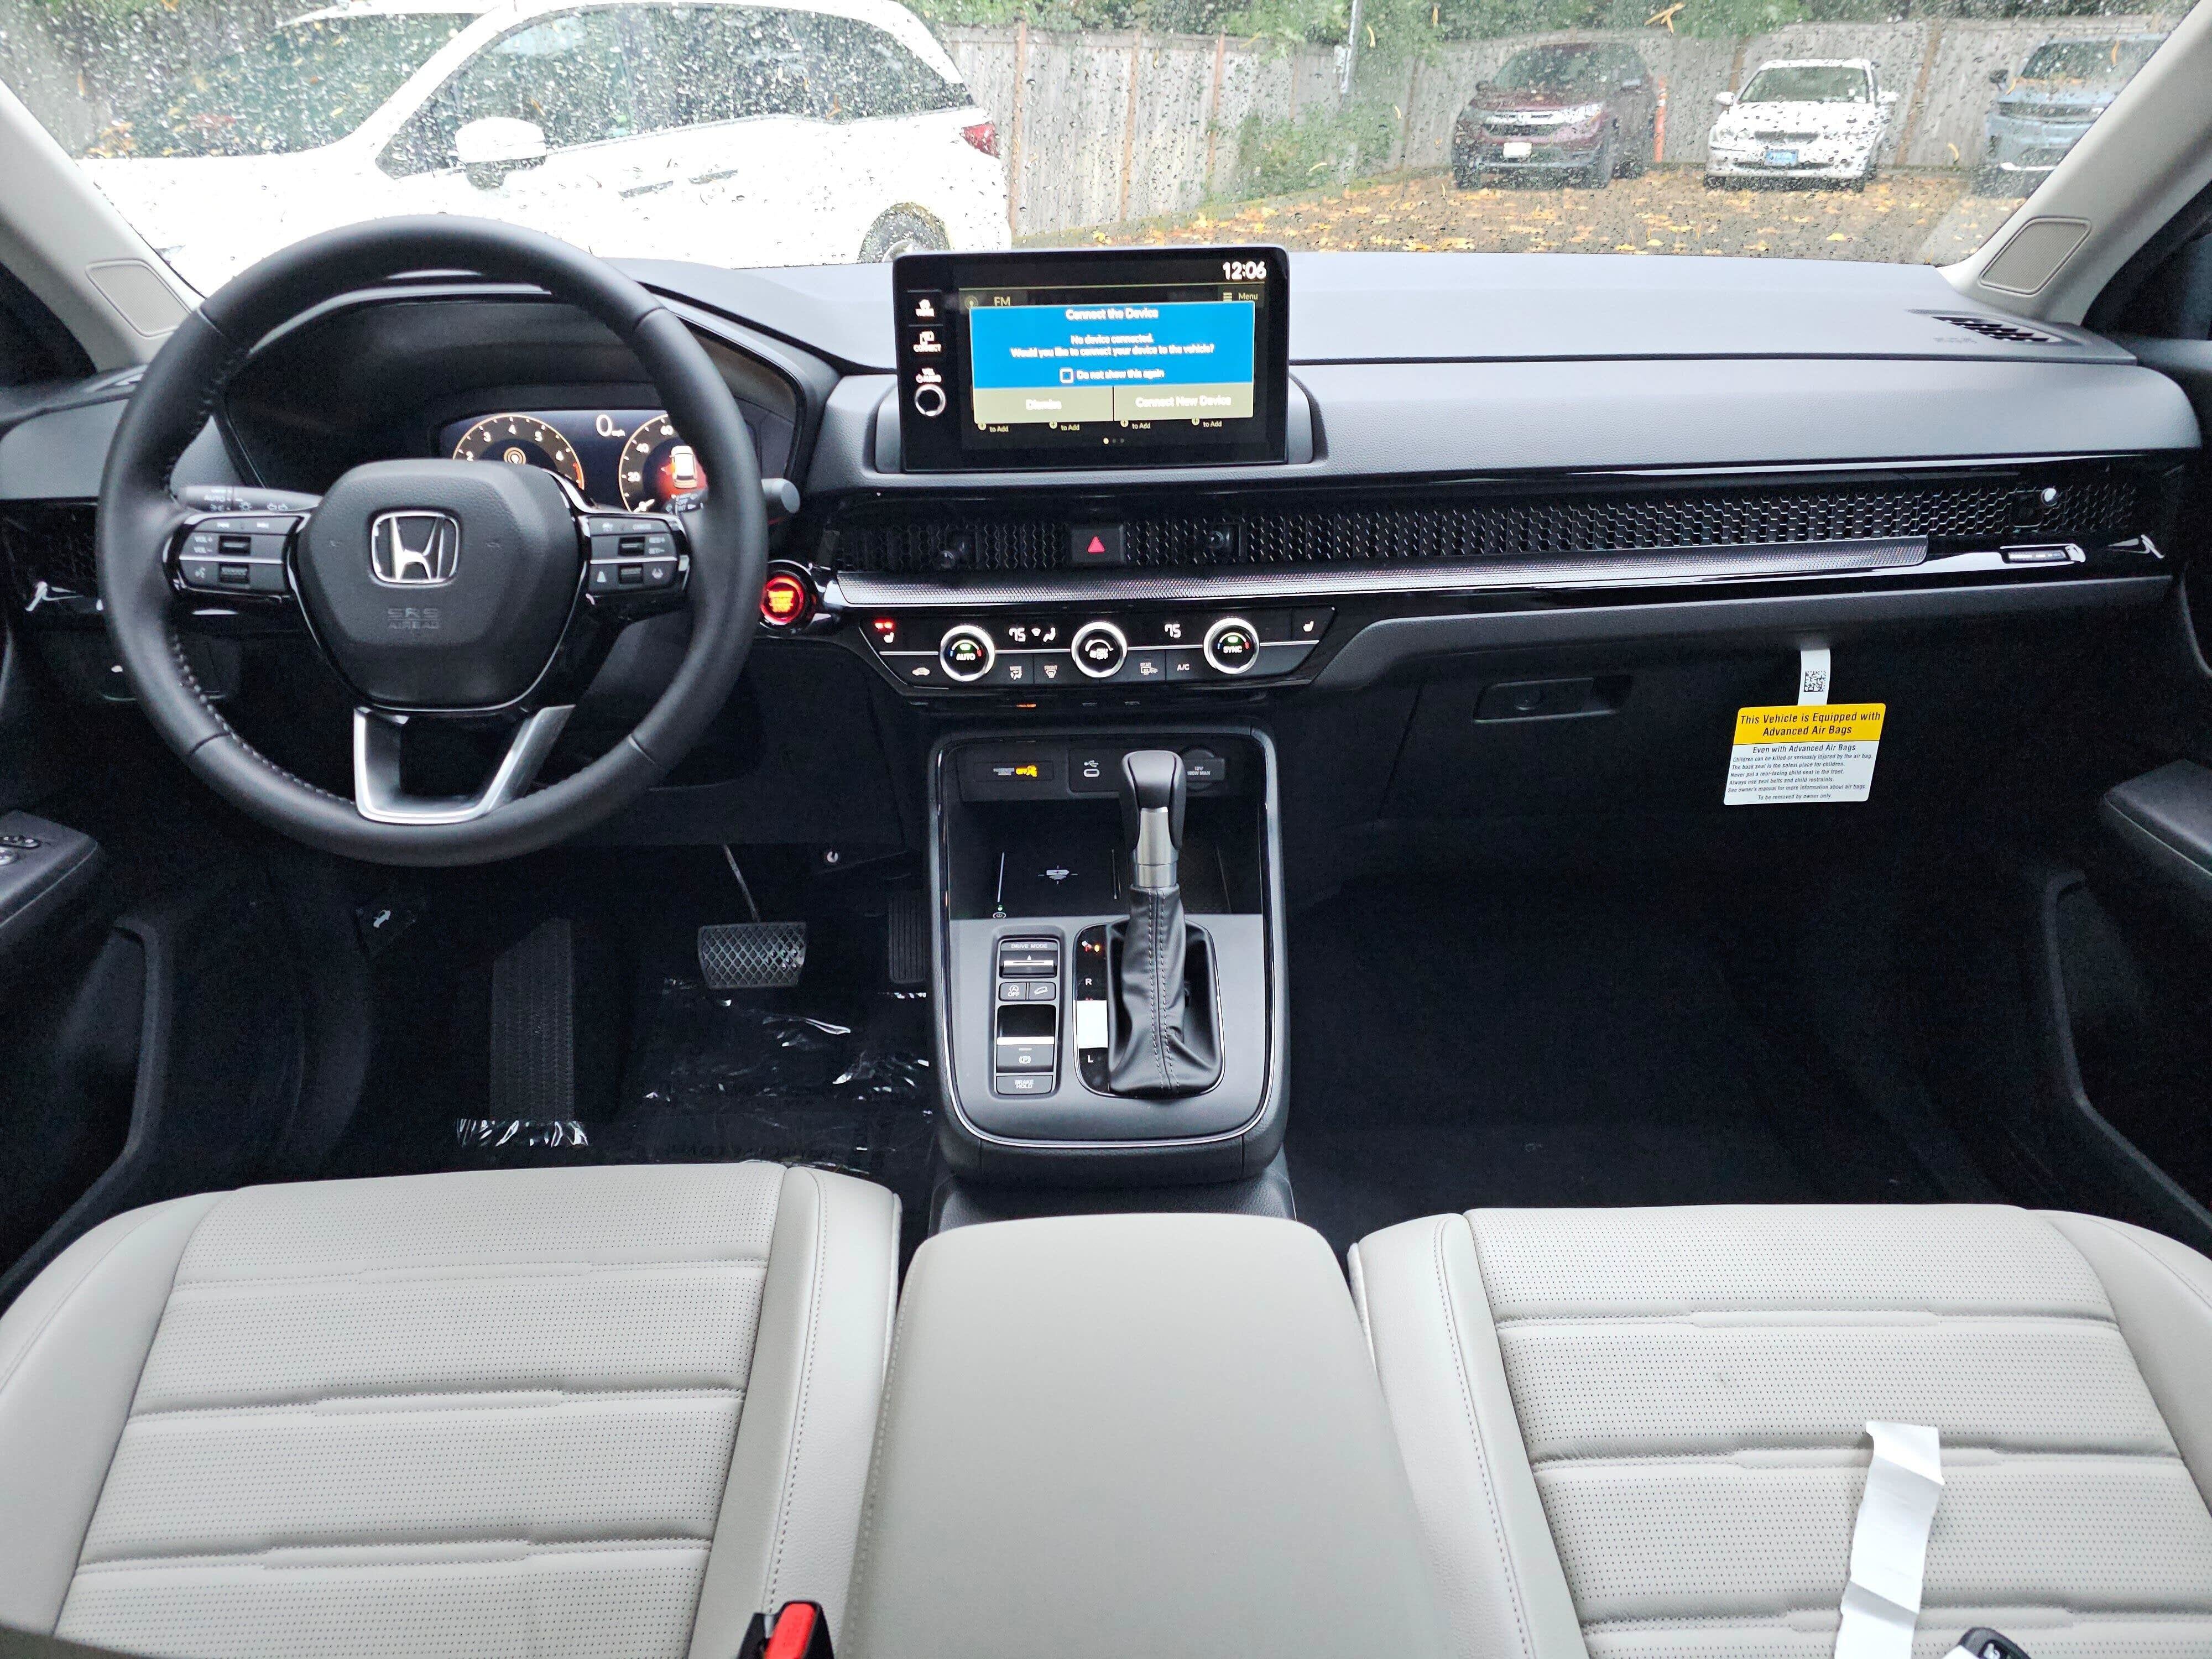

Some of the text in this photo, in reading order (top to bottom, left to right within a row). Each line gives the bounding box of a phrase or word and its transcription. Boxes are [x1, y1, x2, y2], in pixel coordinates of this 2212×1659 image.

[1222, 261, 1267, 280] 12:06
[994, 296, 1011, 306] FM
[1065, 307, 1159, 321] Connect the Device
[1071, 335, 1084, 345] No
[1084, 334, 1110, 344] device
[1010, 347, 1038, 358] Would
[1038, 348, 1053, 358] you
[1054, 347, 1069, 357] like
[1070, 347, 1079, 357] to
[1079, 347, 1112, 356] connect
[1112, 347, 1131, 357] your
[1131, 346, 1157, 355] device
[1158, 346, 1168, 354] to
[1168, 345, 1182, 354] the
[1076, 369, 1165, 380] Do not show this again
[1135, 395, 1232, 408] Connect New Device
[509, 425, 517, 435] 4
[596, 414, 612, 436] 0
[483, 431, 491, 442] 3
[535, 431, 542, 442] 5
[636, 444, 649, 453] 40
[627, 472, 641, 482] 20
[1009, 628, 1026, 641] 75
[1165, 624, 1181, 638] 75
[1223, 645, 1243, 654] SYNC
[1741, 712, 1880, 724] This Vehicle is Equipped with
[1763, 725, 1852, 736] Advanced Air Bags
